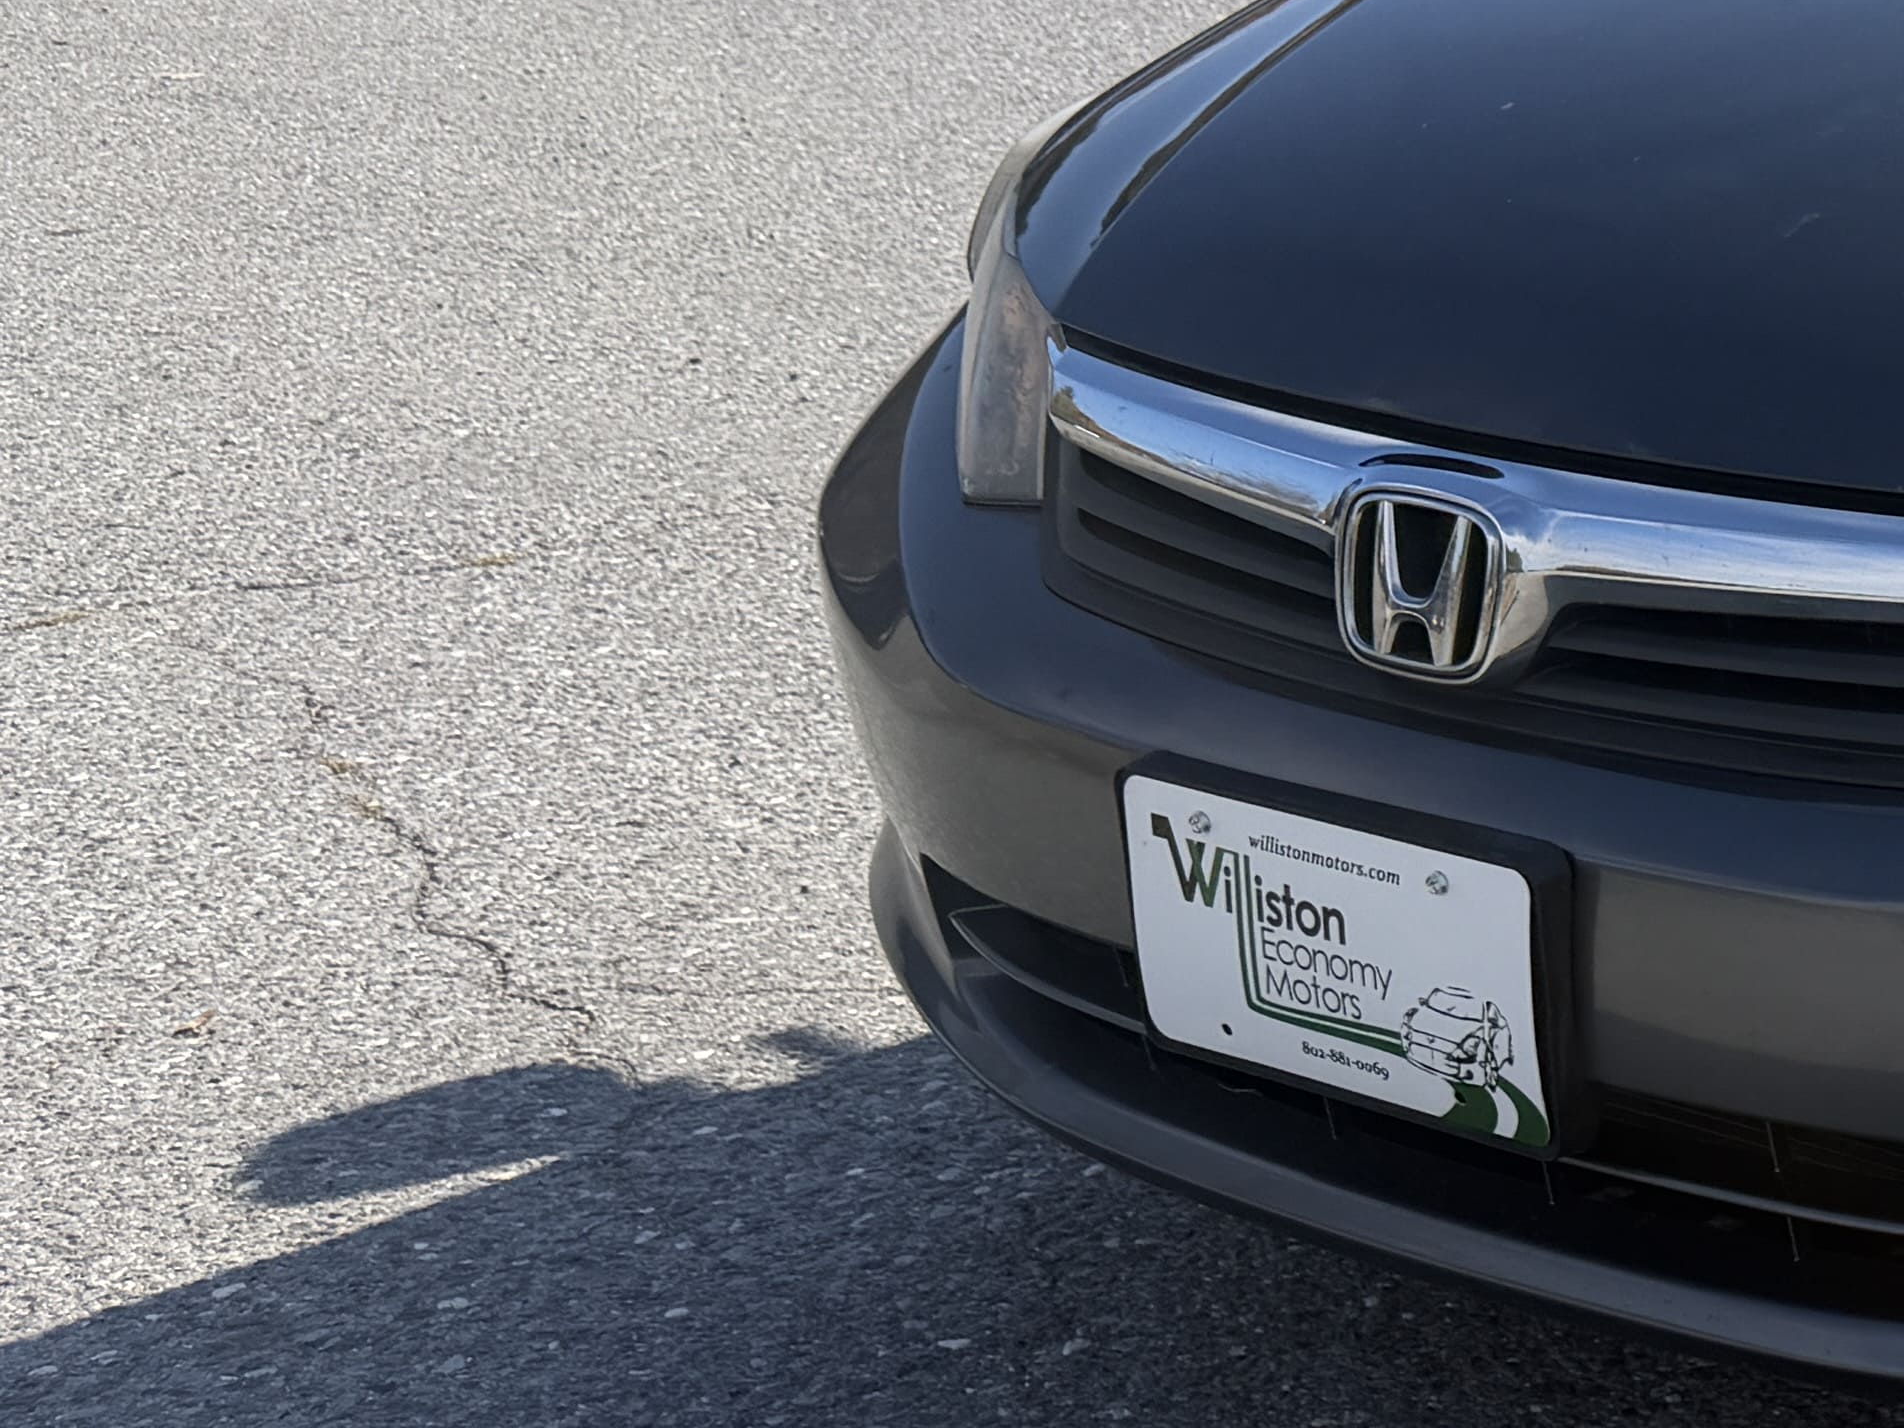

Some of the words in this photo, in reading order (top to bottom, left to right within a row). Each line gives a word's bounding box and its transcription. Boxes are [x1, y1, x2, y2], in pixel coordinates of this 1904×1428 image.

[1150, 812, 1346, 946] Williston
[1248, 835, 1400, 886] willistonmotors.com
[1261, 926, 1392, 1001] Economy
[1266, 963, 1362, 1020] Motors
[1302, 1040, 1390, 1081] 802-881-0069
